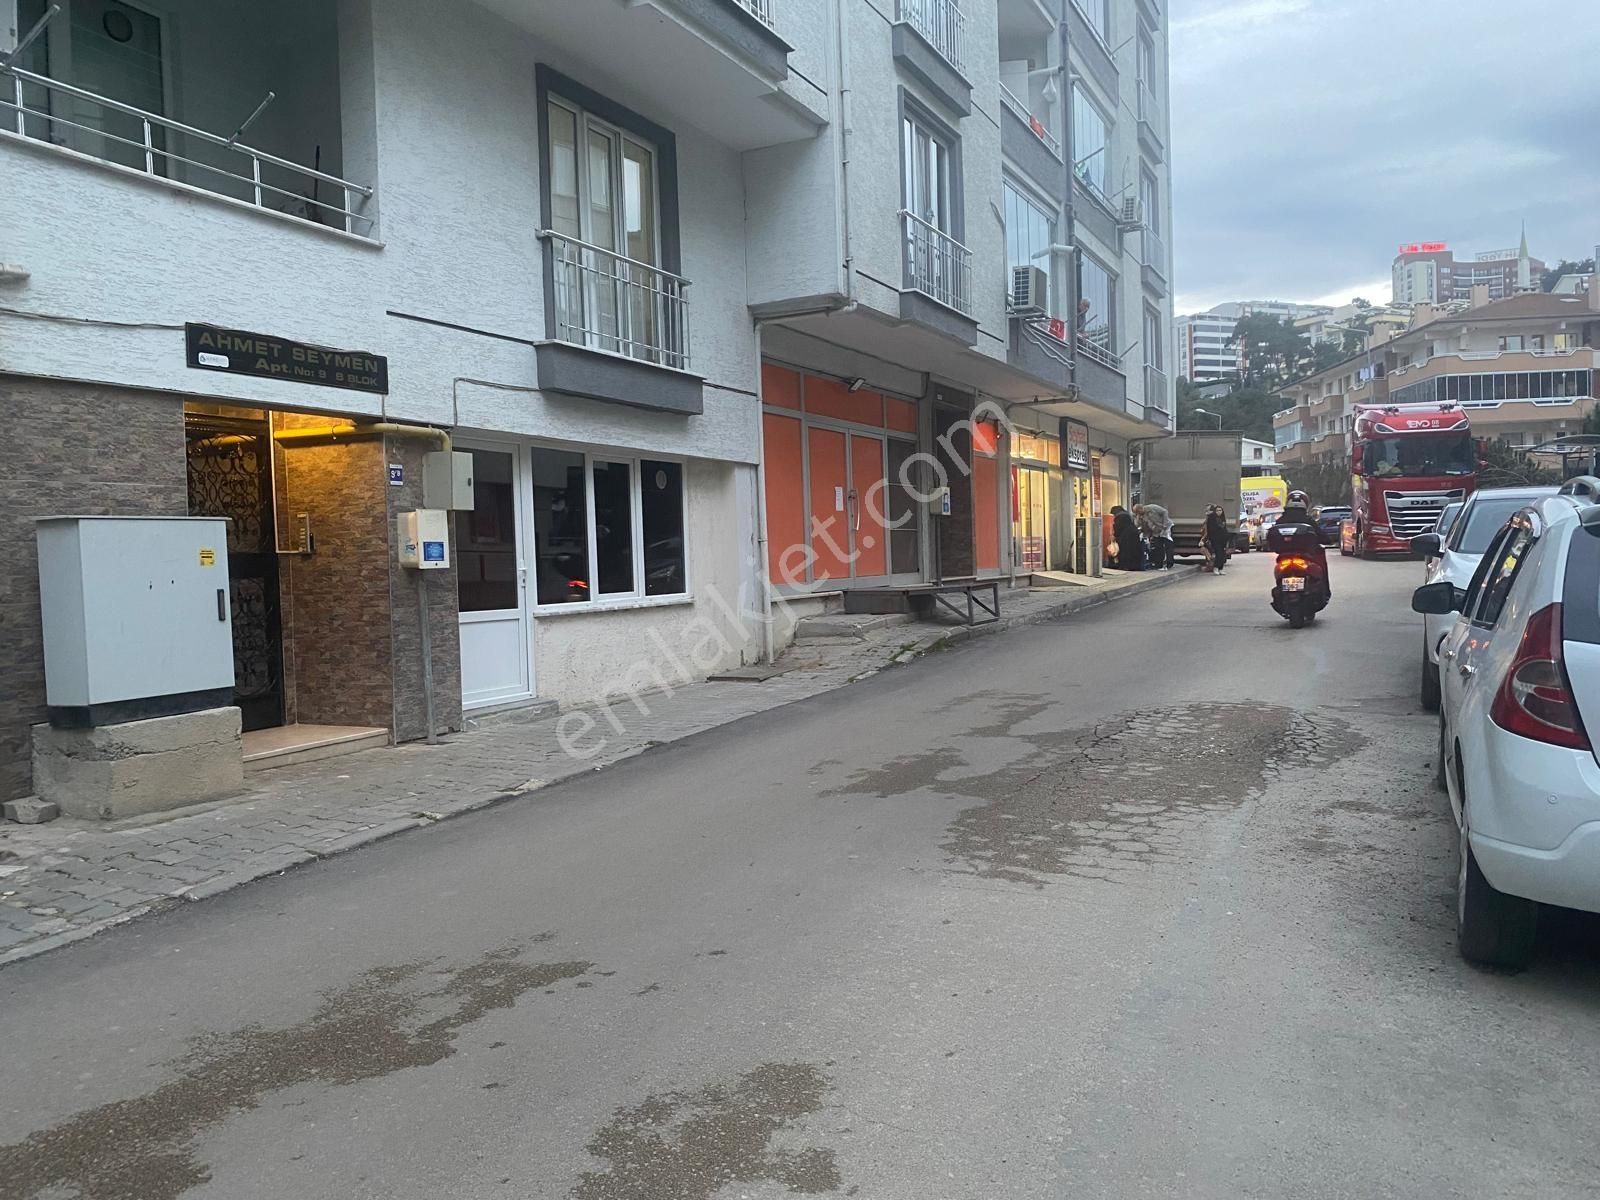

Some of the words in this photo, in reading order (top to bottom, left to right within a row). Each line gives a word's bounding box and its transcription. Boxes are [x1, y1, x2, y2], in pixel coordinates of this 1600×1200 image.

[199, 332, 283, 358] AHMET
[292, 347, 378, 373] SEYMEN
[256, 358, 291, 374] Apt.
[348, 374, 377, 386] BLOK
